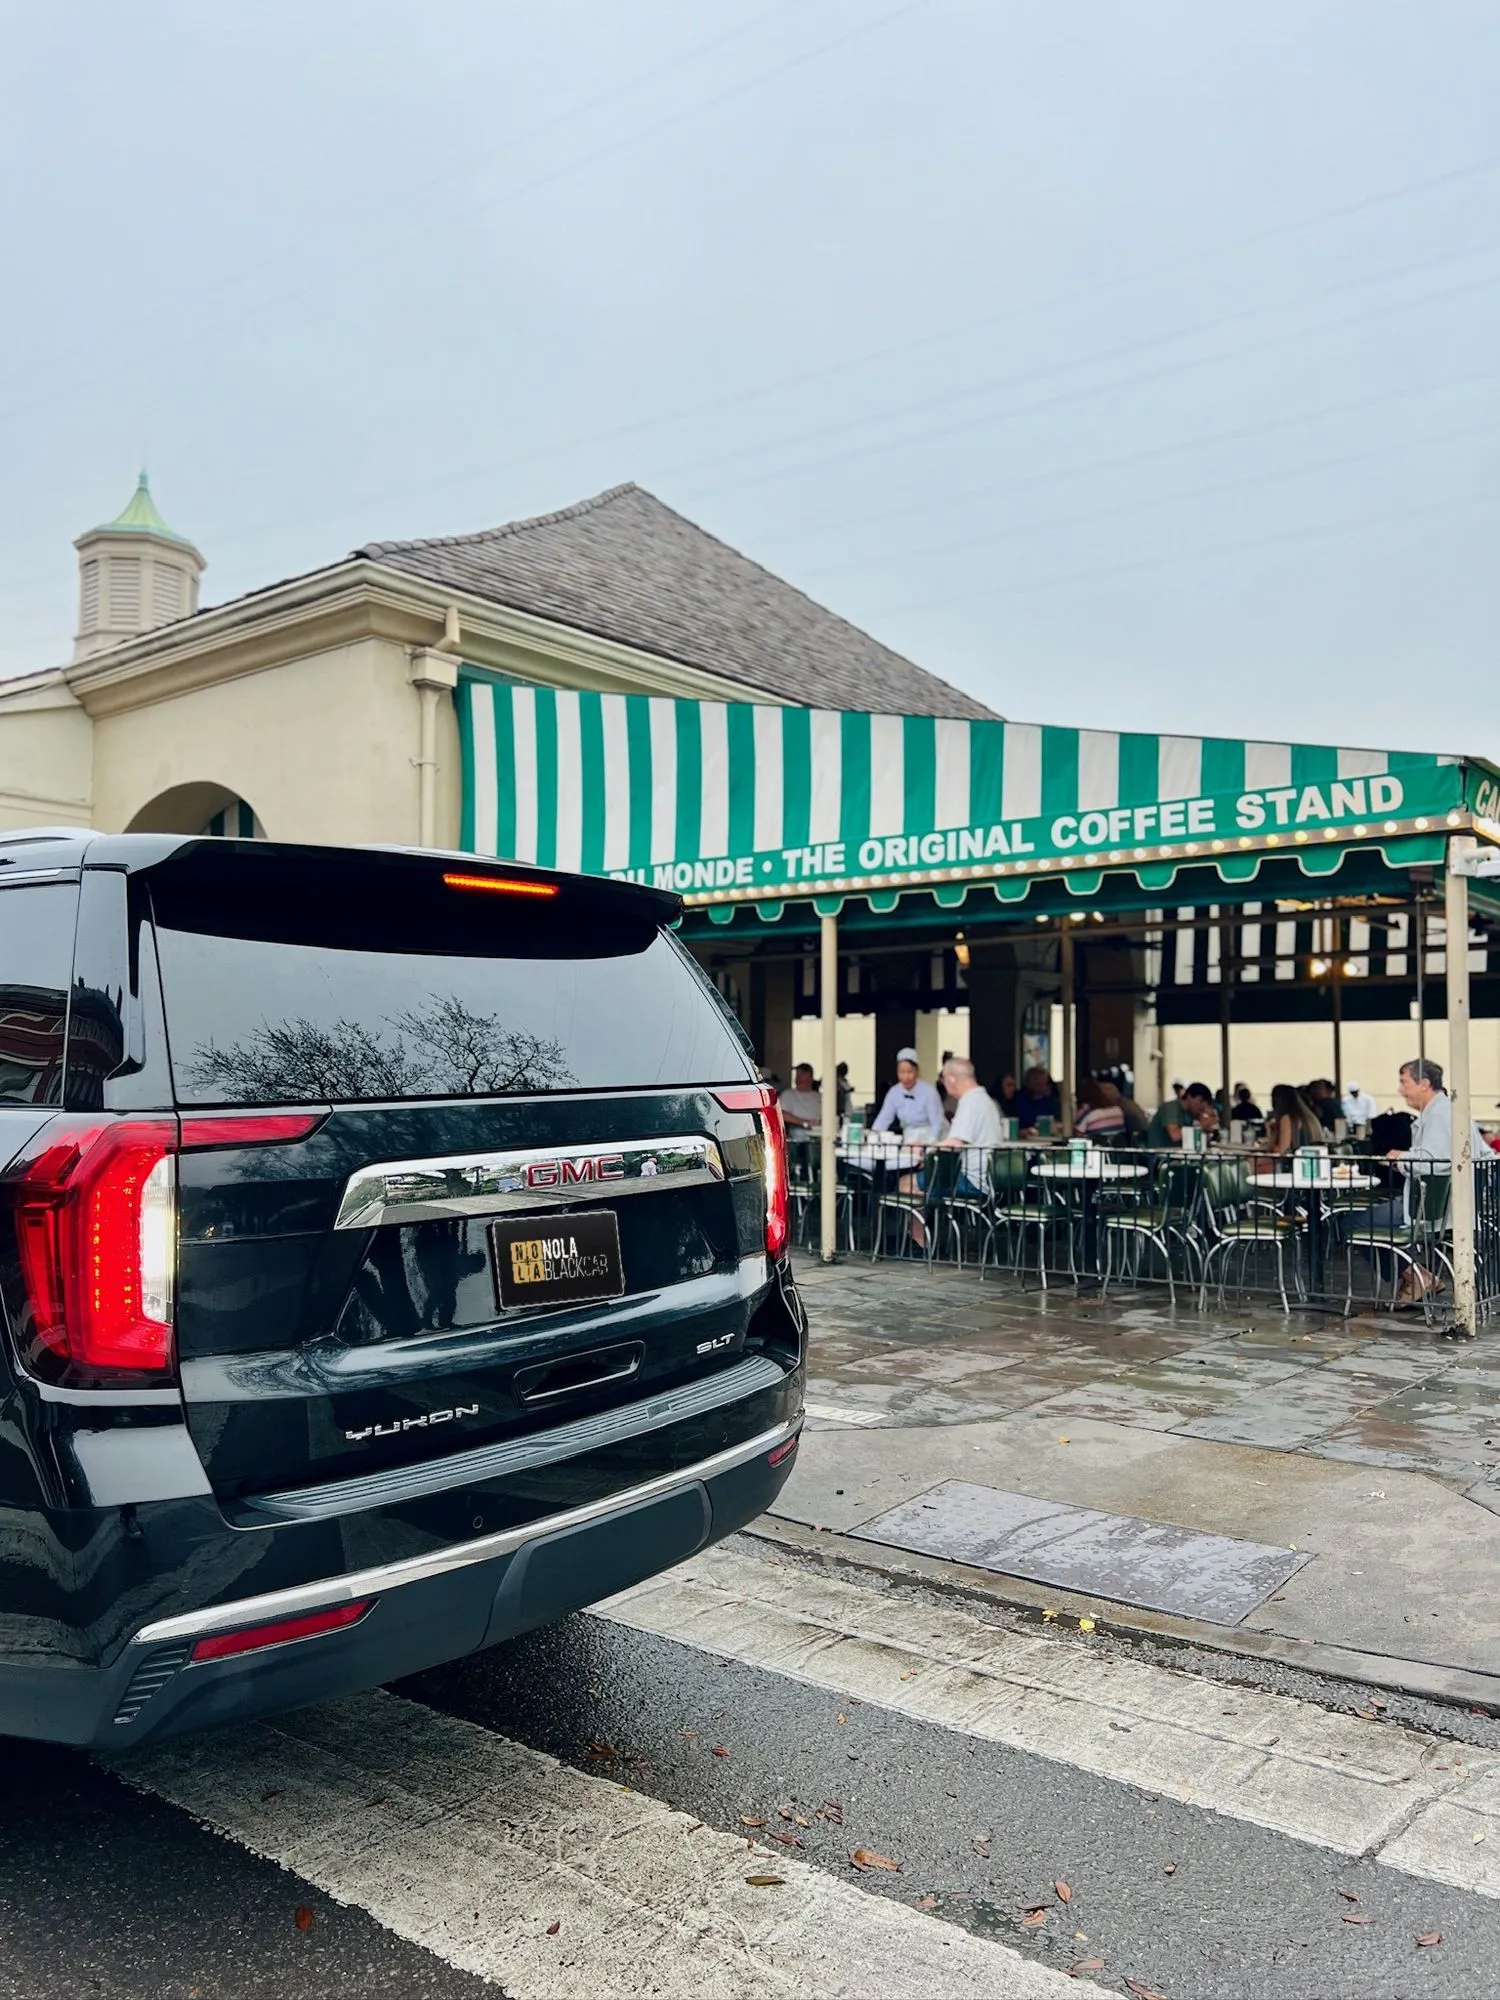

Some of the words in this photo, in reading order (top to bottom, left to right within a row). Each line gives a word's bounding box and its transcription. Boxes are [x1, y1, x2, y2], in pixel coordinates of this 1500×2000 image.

[1475, 780, 1500, 823] CA
[654, 857, 754, 891] MONDE
[782, 843, 846, 878] THE
[858, 823, 1035, 870] ORIGINAL
[1051, 799, 1216, 849] COFFEE
[1235, 776, 1404, 829] STAND
[521, 1154, 625, 1189] GMC
[542, 1237, 579, 1260] NOLA
[696, 1332, 736, 1355] SLT
[345, 1403, 479, 1441] YUKON
